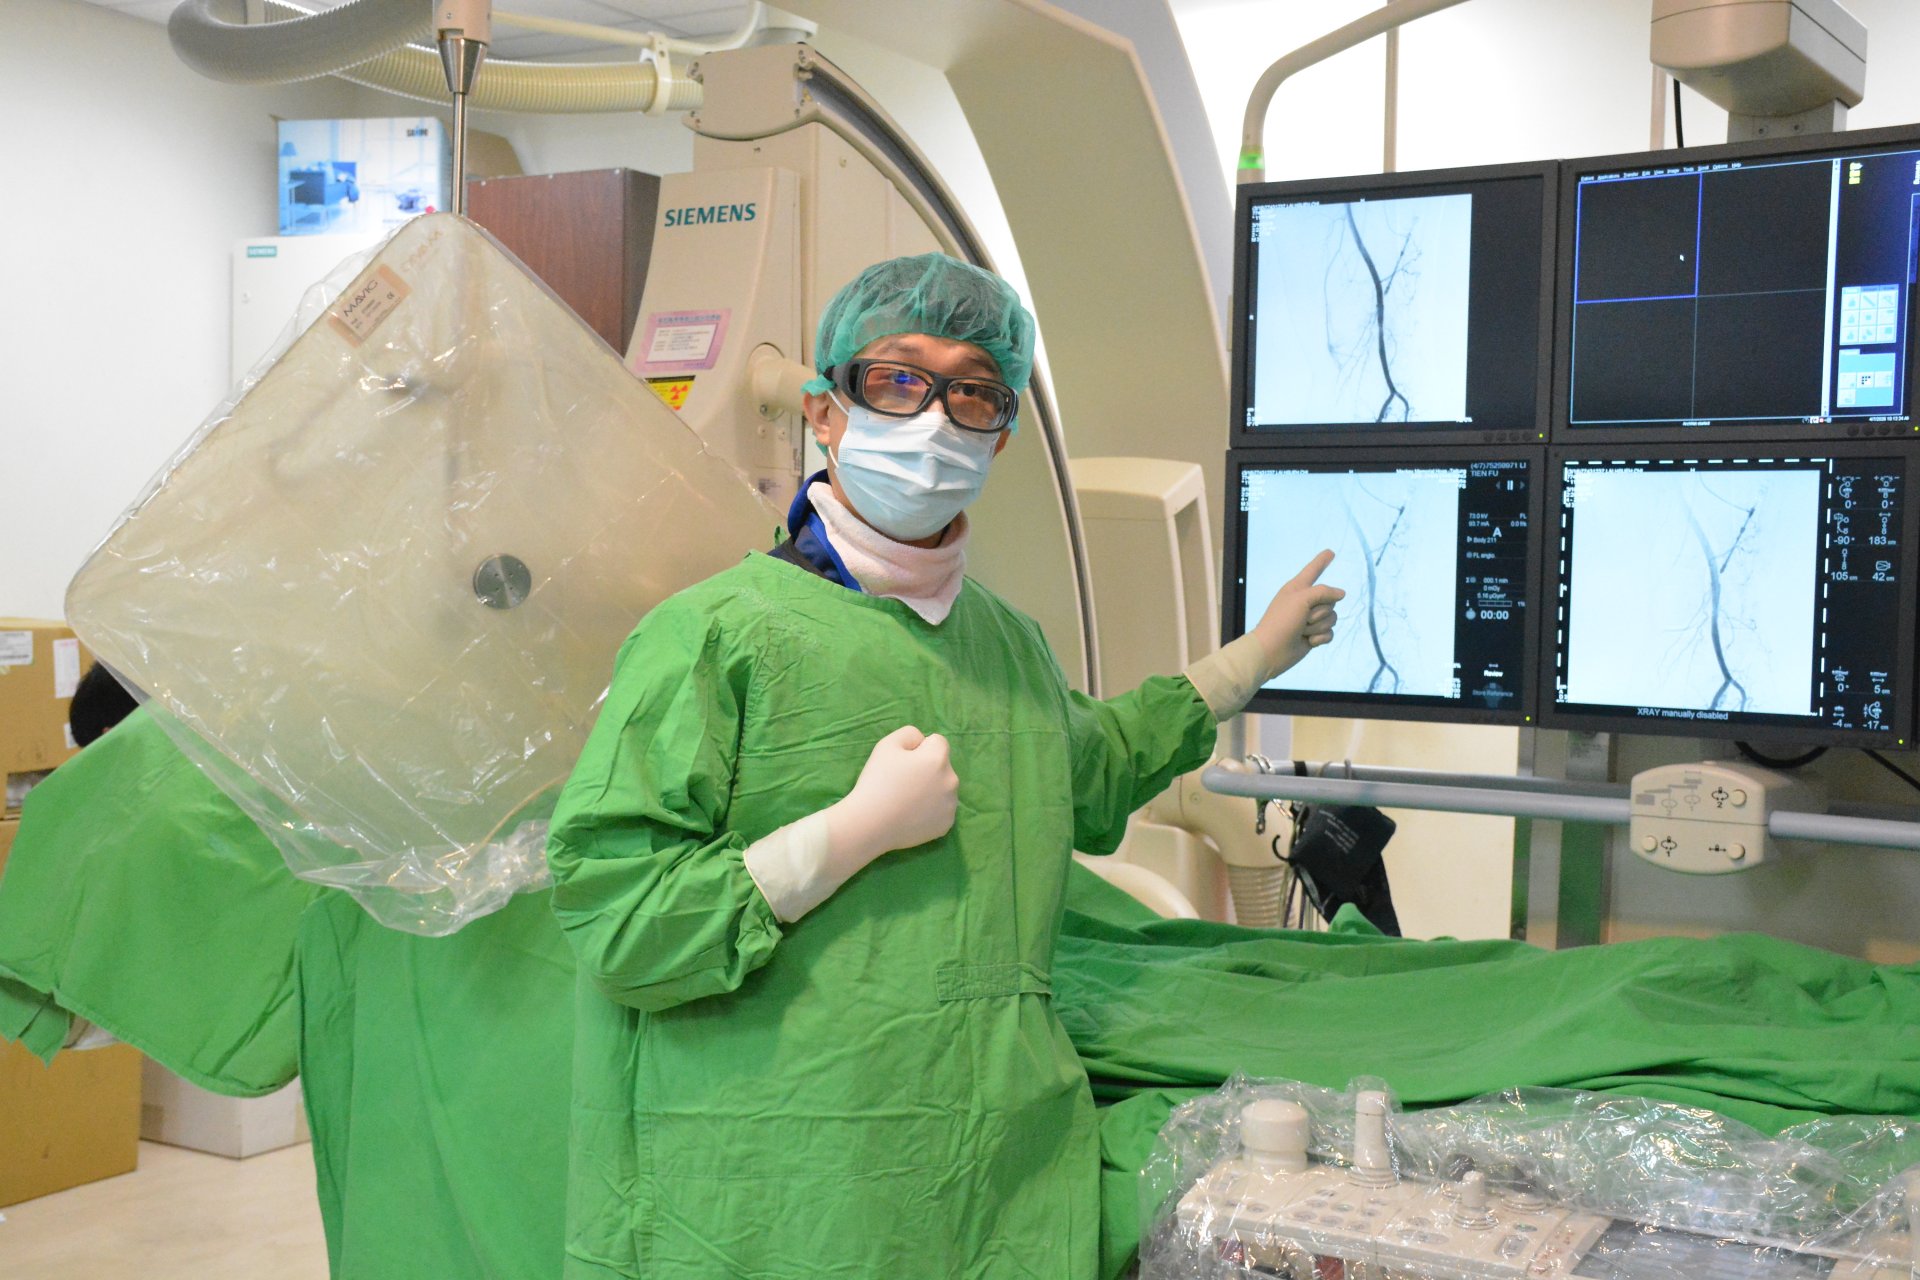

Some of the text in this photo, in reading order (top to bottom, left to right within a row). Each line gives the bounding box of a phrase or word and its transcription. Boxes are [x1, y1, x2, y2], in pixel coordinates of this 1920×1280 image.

[664, 203, 756, 227] SIEMENS
[343, 279, 378, 317] MAVIG
[1492, 526, 1502, 537] A
[1869, 536, 1887, 545] 183
[1831, 572, 1849, 580] 105
[1872, 572, 1885, 581] 42
[1480, 609, 1509, 620] 00:00
[1874, 684, 1881, 694] 5
[1637, 707, 1729, 720] XRAY manually disabled
[1833, 719, 1843, 728] -4
[1863, 721, 1880, 730] -17
[1717, 801, 1723, 809] 2
